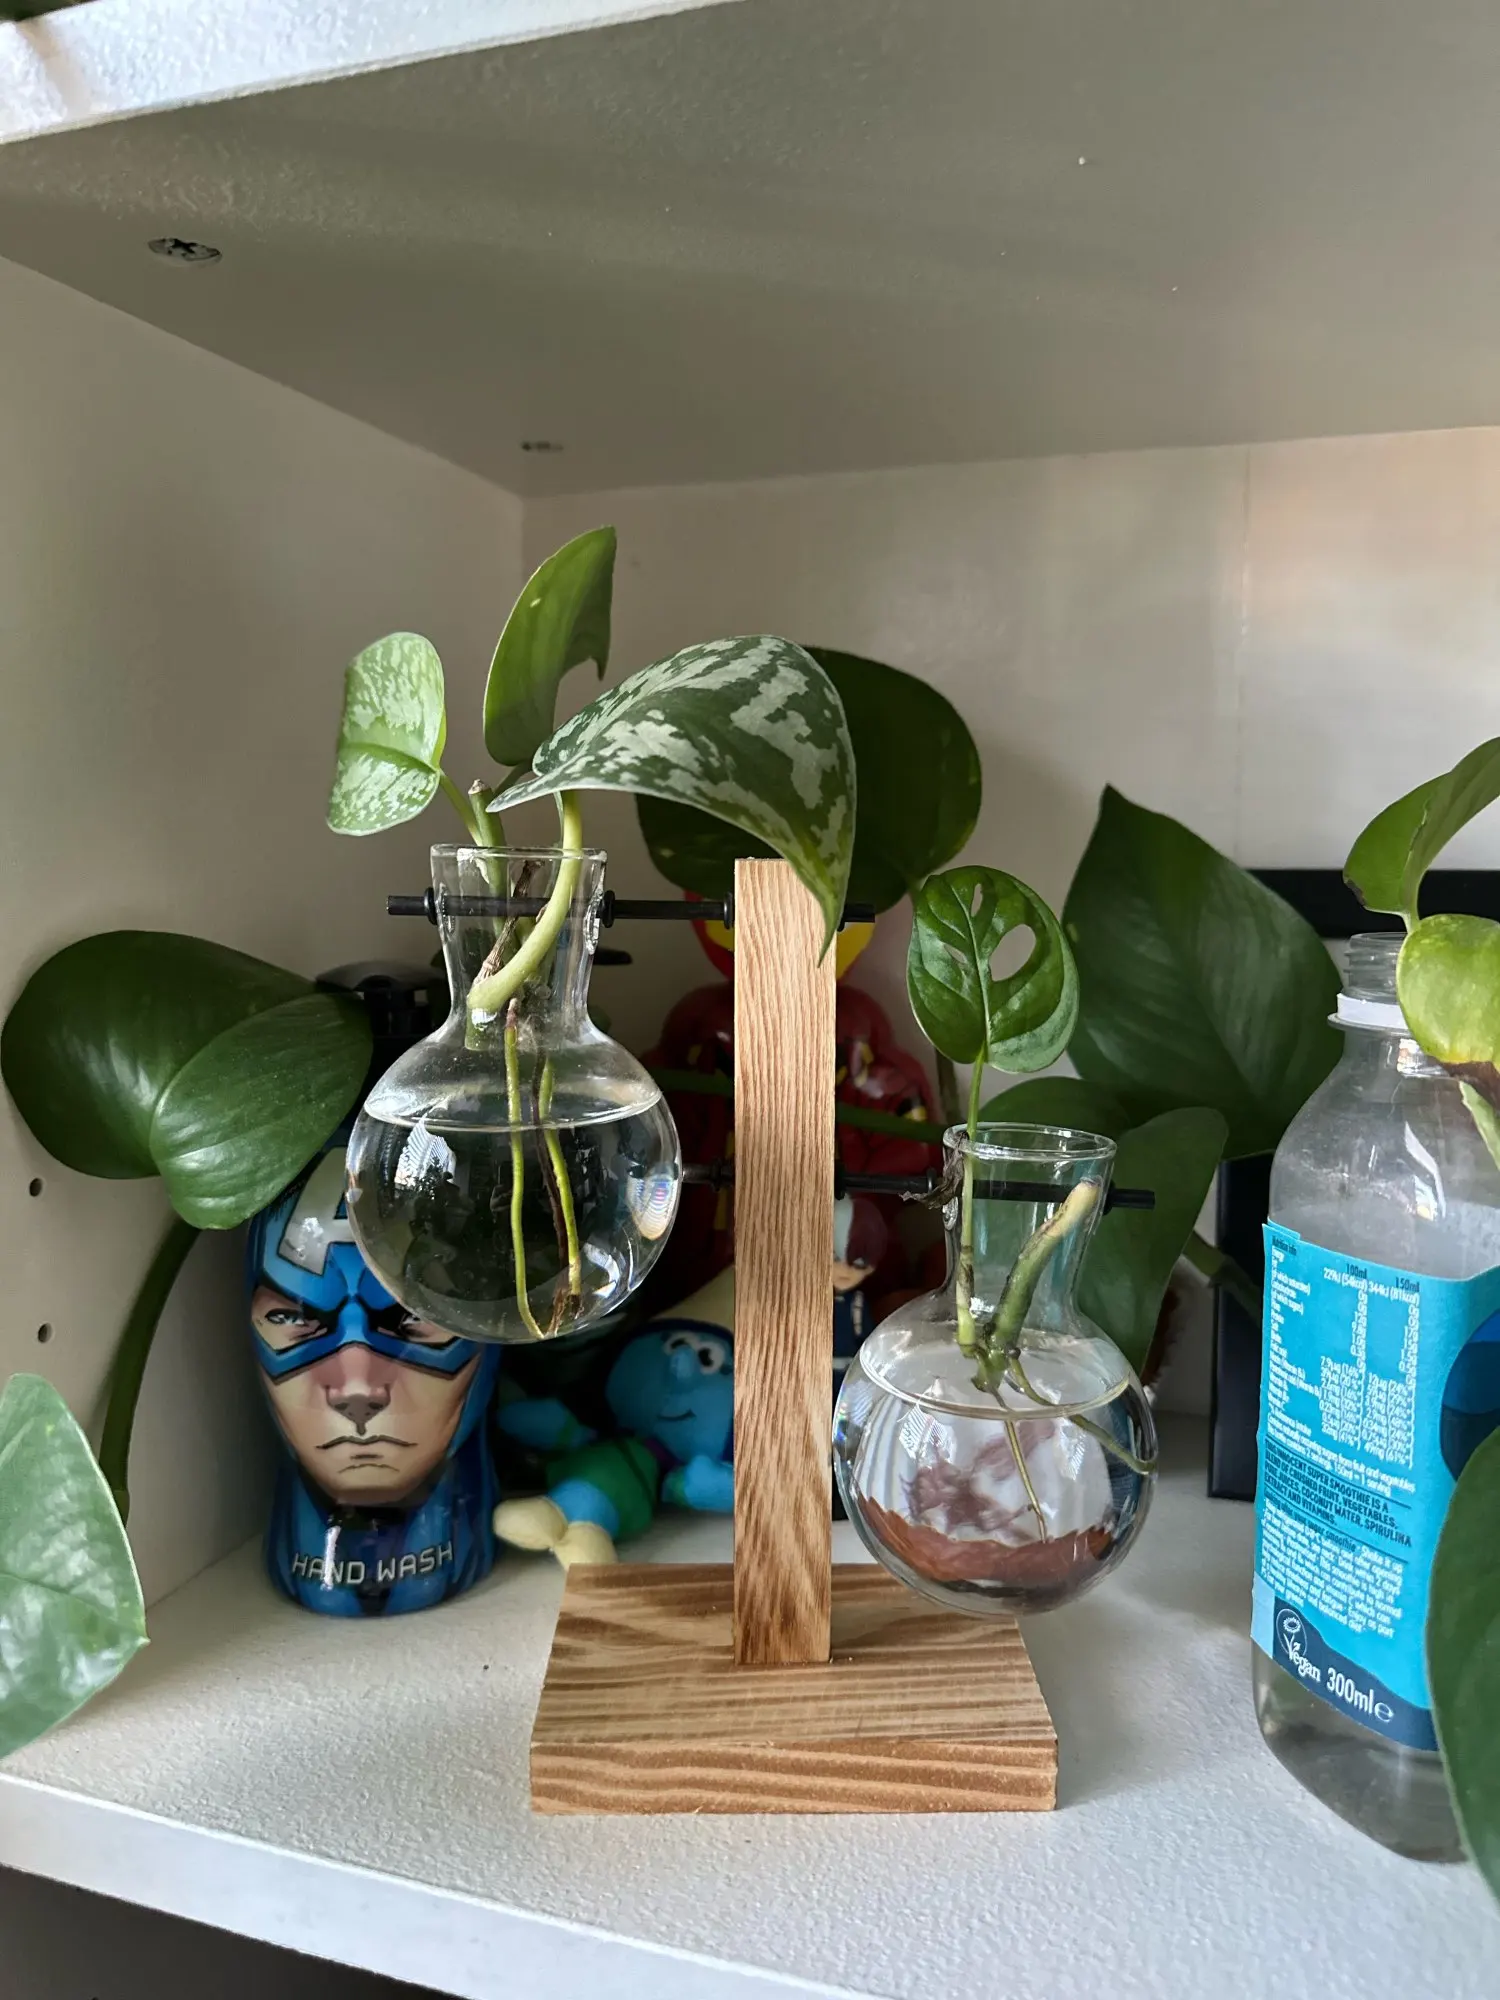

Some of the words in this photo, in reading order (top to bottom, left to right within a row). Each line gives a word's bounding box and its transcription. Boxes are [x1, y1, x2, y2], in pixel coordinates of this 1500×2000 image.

[1346, 1263, 1367, 1278] 100ml
[1395, 1277, 1419, 1291] 150ml
[1266, 1450, 1280, 1468] BLEND
[1281, 1461, 1288, 1473] OF
[1289, 1466, 1316, 1491] CRUSHED
[1277, 1447, 1306, 1473] INNOCENT
[1306, 1465, 1328, 1485] SUPER
[1329, 1476, 1370, 1506] SMOOTHIE
[1371, 1497, 1380, 1509] IS
[1382, 1501, 1388, 1512] A
[1264, 1471, 1287, 1496] EXTRACT
[1288, 1489, 1300, 1505] AND
[1302, 1497, 1336, 1526] VITAMINS.
[1264, 1460, 1277, 1476] PURE
[1301, 1485, 1332, 1511] COCONUT
[1364, 1517, 1412, 1546] SPIRULINA
[291, 1552, 366, 1584] HAND
[376, 1541, 453, 1582] WASH
[1326, 1528, 1354, 1552] smoothie
[1283, 1632, 1321, 1683] Vegan
[1326, 1667, 1374, 1714] 300ml
